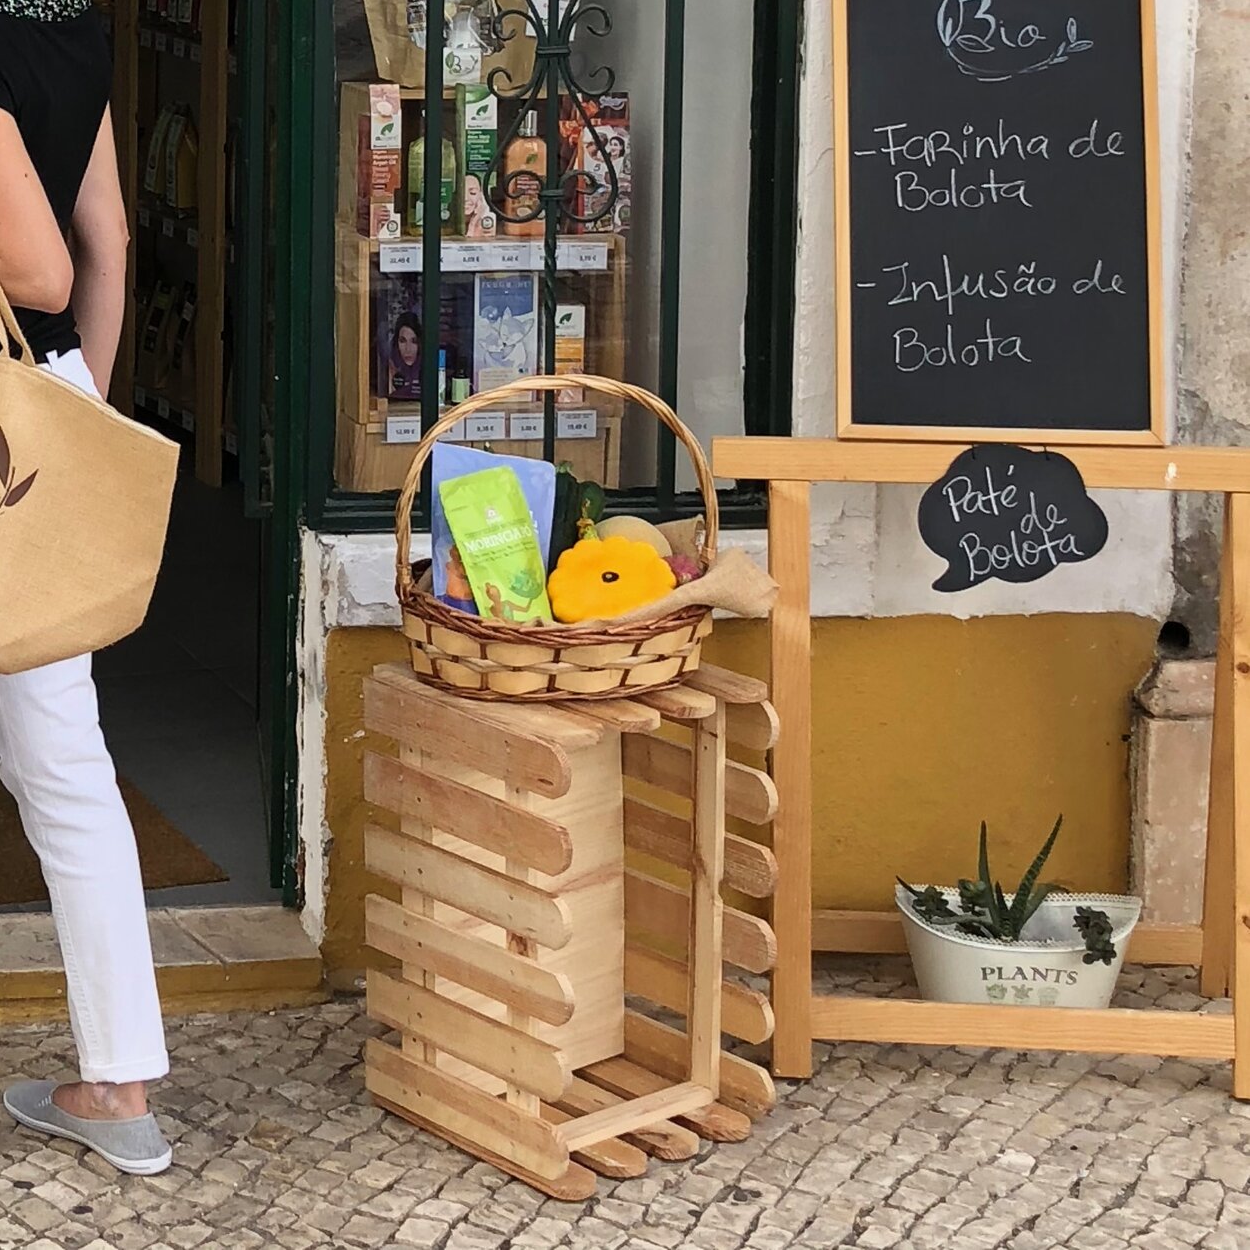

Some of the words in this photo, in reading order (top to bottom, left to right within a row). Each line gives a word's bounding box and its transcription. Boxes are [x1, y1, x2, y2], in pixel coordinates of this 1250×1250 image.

[1069, 119, 1125, 159] de
[894, 168, 1032, 211] Bolota
[1073, 260, 1126, 295] de
[893, 318, 1032, 372] Bolota
[942, 464, 1018, 522] Paté
[1020, 491, 1068, 534] de
[959, 530, 1085, 581] Bolota
[980, 965, 1079, 986] PLANTS
